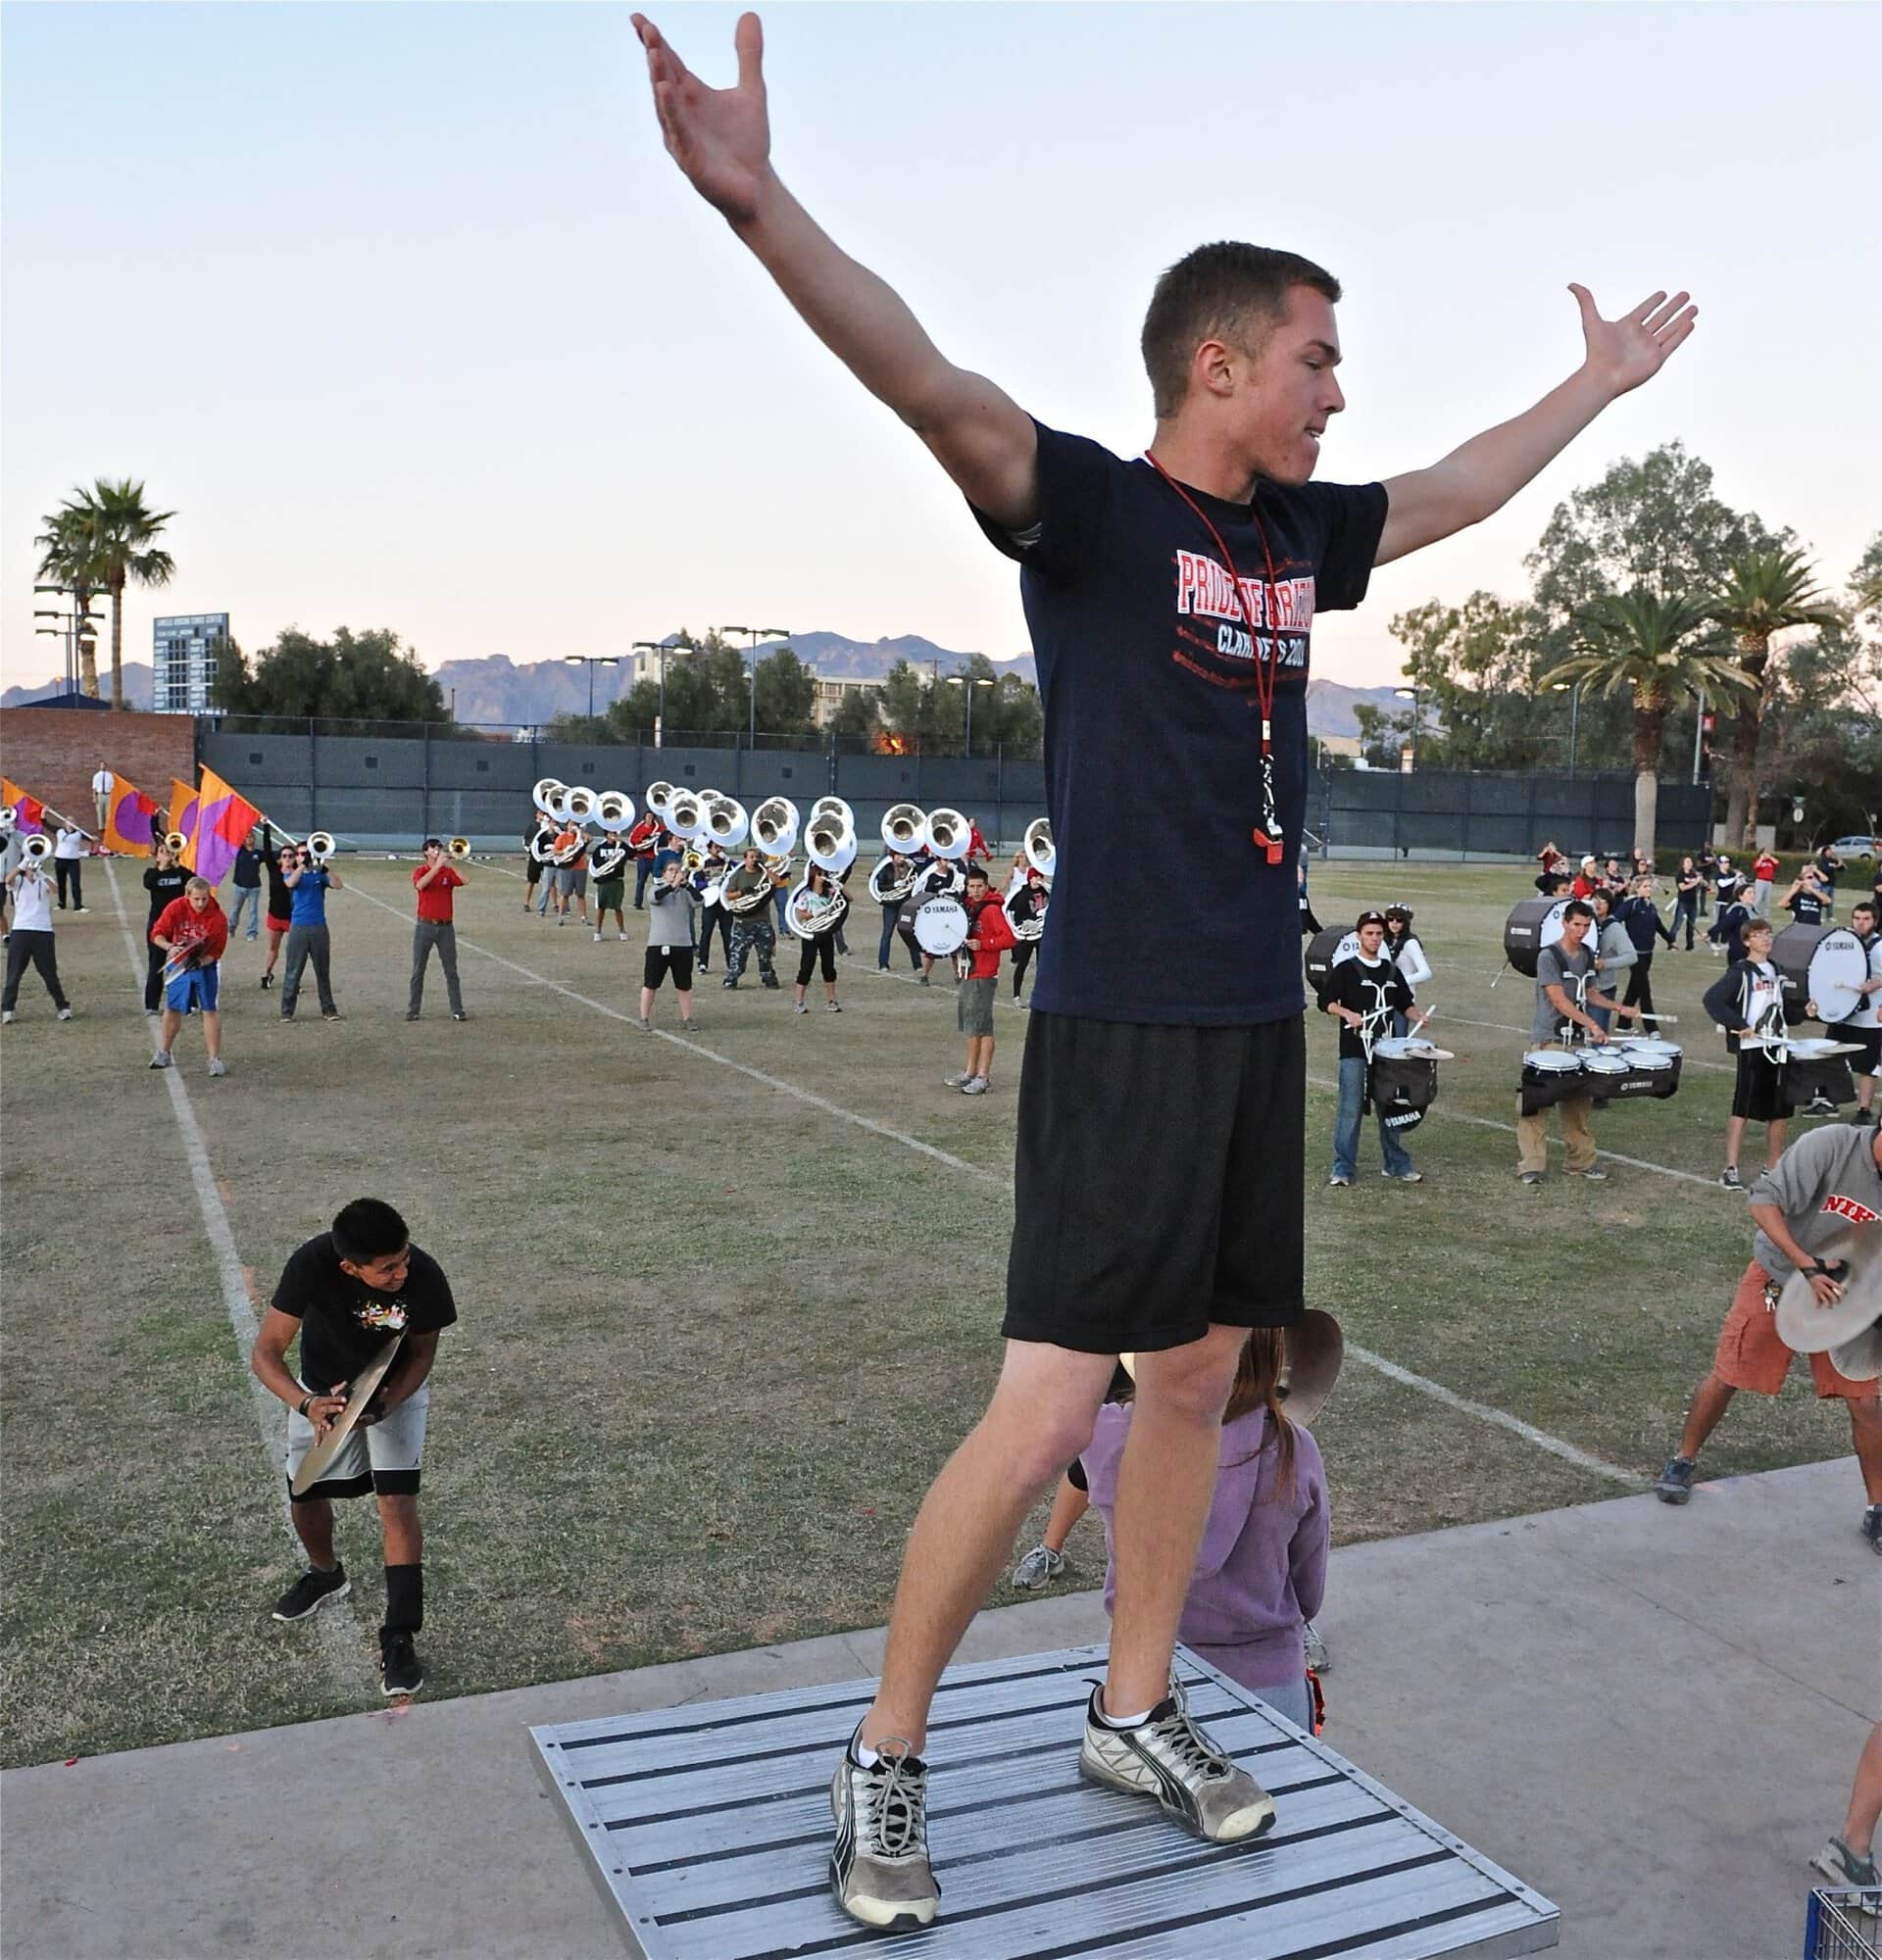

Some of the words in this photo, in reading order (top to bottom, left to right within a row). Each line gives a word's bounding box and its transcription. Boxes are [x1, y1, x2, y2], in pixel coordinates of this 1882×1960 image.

[1176, 549, 1241, 622] PRIDE
[1217, 624, 1287, 664] CLARNES
[1391, 1110, 1421, 1127] YAMAHA
[1819, 1194, 1880, 1223] NIK
